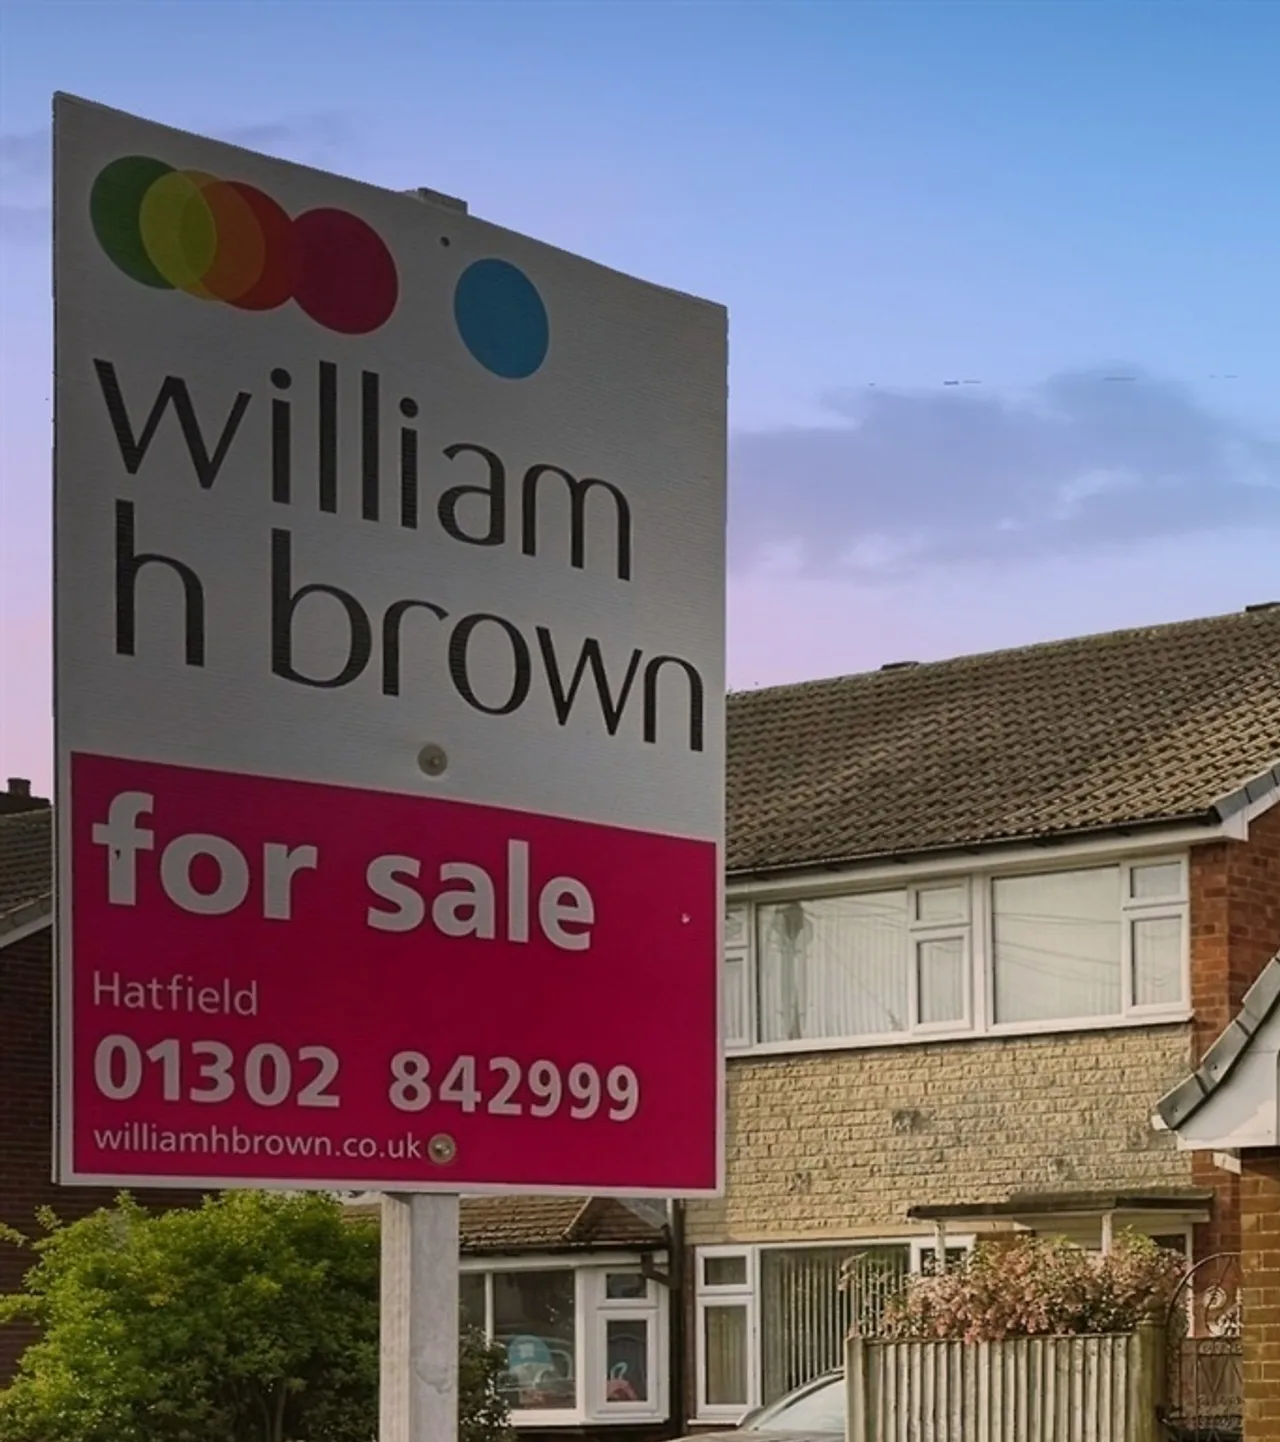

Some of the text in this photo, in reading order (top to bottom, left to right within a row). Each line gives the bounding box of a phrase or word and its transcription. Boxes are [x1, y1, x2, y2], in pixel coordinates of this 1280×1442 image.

[93, 357, 632, 582] william
[115, 498, 704, 753] h brown
[92, 791, 596, 951] for sale
[93, 971, 258, 1016] Hatfield
[94, 1034, 640, 1122] 01302 842999
[93, 1122, 422, 1160] williamhbrown.co.uk
